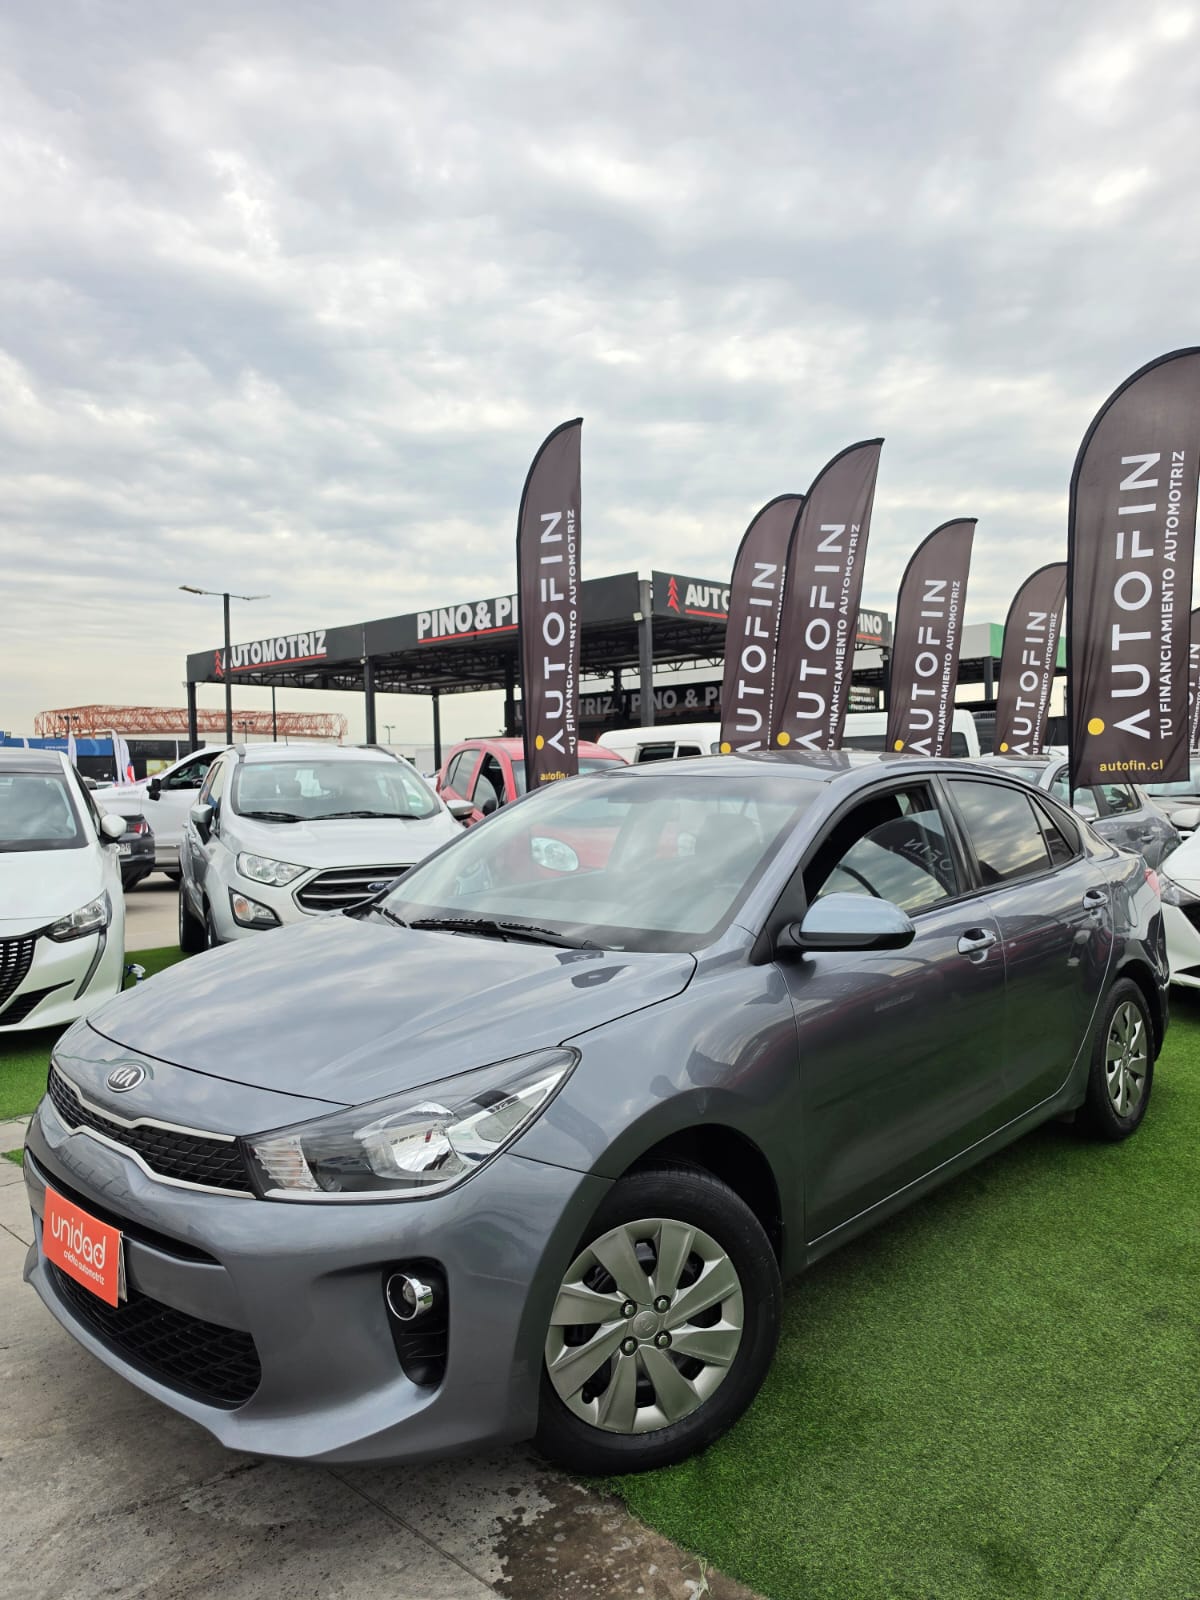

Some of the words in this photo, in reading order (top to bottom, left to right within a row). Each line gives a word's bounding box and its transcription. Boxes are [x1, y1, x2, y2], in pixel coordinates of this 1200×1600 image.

[567, 508, 577, 605] AUTOMOTRIZ
[1163, 451, 1185, 562] AUTOMOTRIZ
[417, 604, 473, 640] PINO
[474, 601, 492, 630] &
[540, 511, 566, 754] AUTOFIN
[795, 524, 846, 751] AUTOFIN
[829, 620, 848, 735] FINANCIAMIENTO
[839, 523, 861, 615] AUTOMOTRIZ
[857, 613, 882, 634] INO
[937, 653, 953, 742] FINANCIAMIENTO
[945, 580, 961, 651] AUTOMOTRIZ
[1111, 453, 1161, 740] AUTOFIN
[1159, 568, 1176, 714] FINANCIAMIENTO
[631, 690, 677, 713] PNO
[684, 688, 699, 708] &
[908, 579, 948, 756] AUTOFIN
[1011, 611, 1047, 756] AUTOFIN
[1033, 672, 1049, 746] FINANCIAMIENTO
[1045, 612, 1058, 671] AUTOMOTRIZ
[1160, 717, 1173, 740] TU
[1099, 760, 1164, 772] autofin.cl
[51, 1211, 107, 1270] unidad
